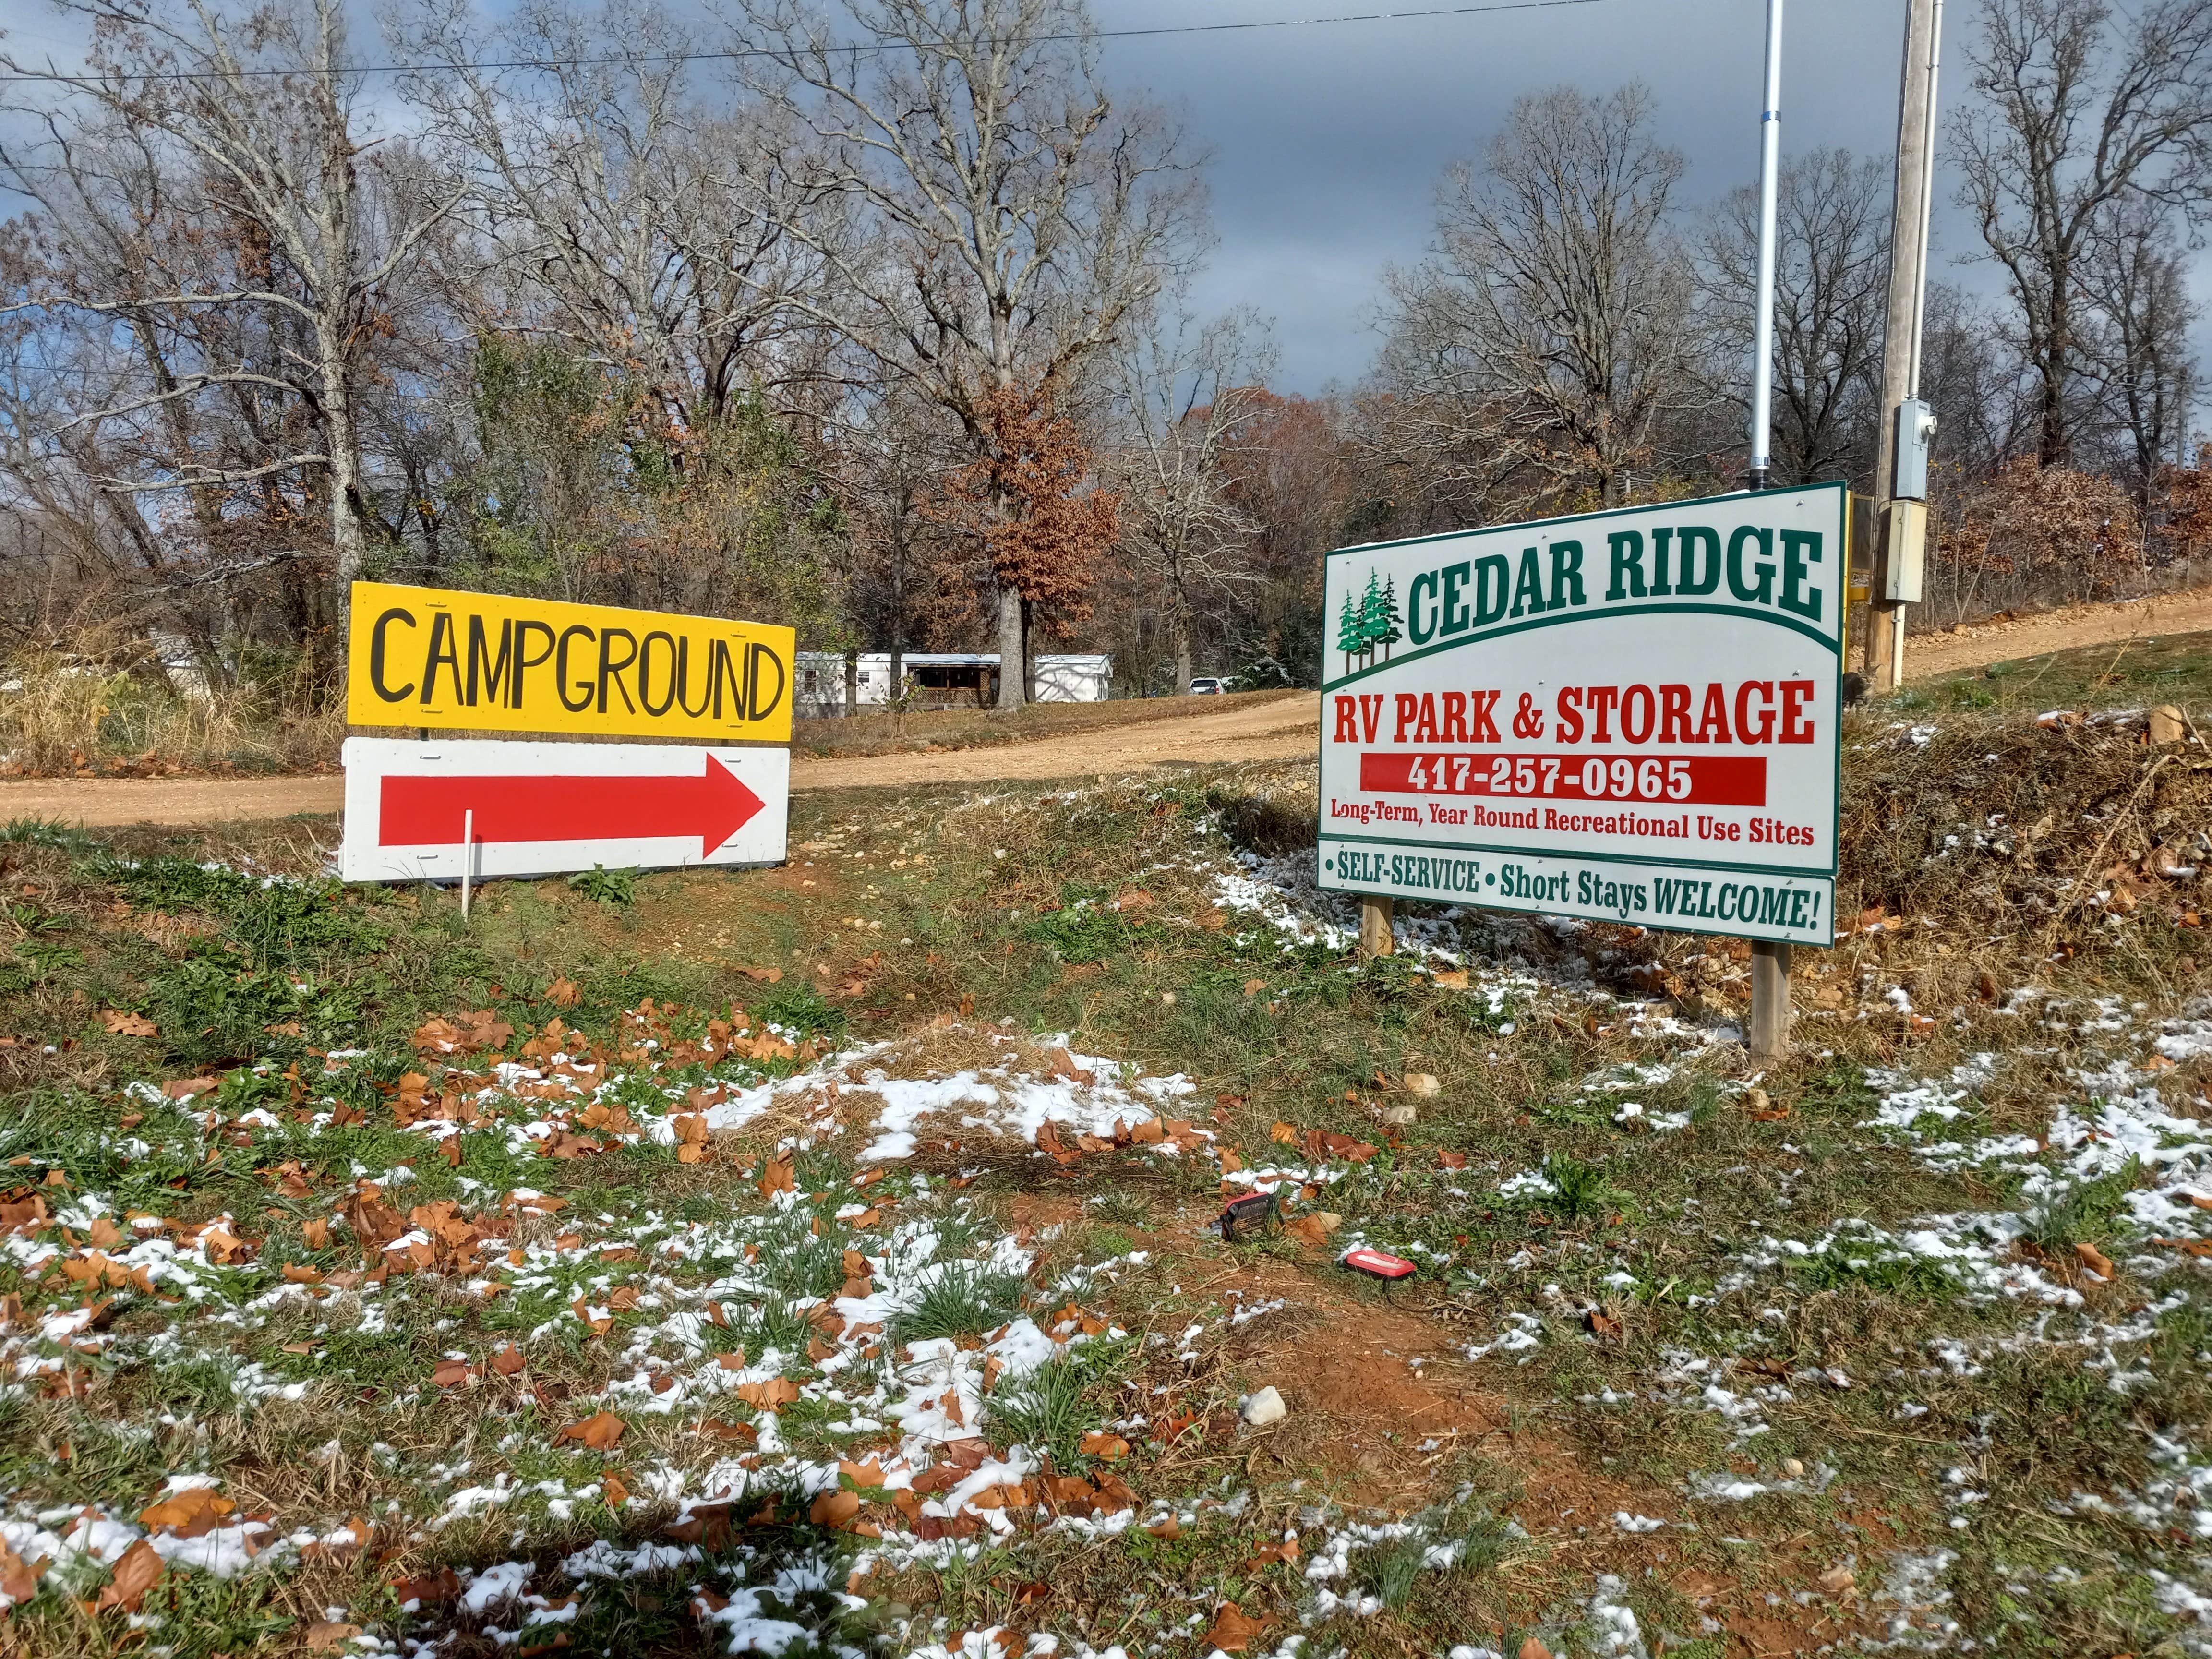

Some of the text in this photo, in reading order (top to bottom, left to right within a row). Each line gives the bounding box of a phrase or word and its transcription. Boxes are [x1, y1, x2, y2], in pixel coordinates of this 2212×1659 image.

[1409, 526, 1822, 645] CEDAR RIDGE
[370, 608, 785, 721] CAMPGROUND
[1334, 680, 1814, 745] RV PARK & STORAGE
[1407, 757, 1692, 799] 417-257-0965
[1331, 799, 1814, 845] Long-Term, Year Round Recreational Use Sites
[1338, 851, 1820, 929] SELF-SERVICE Short Stays WELCOME!
